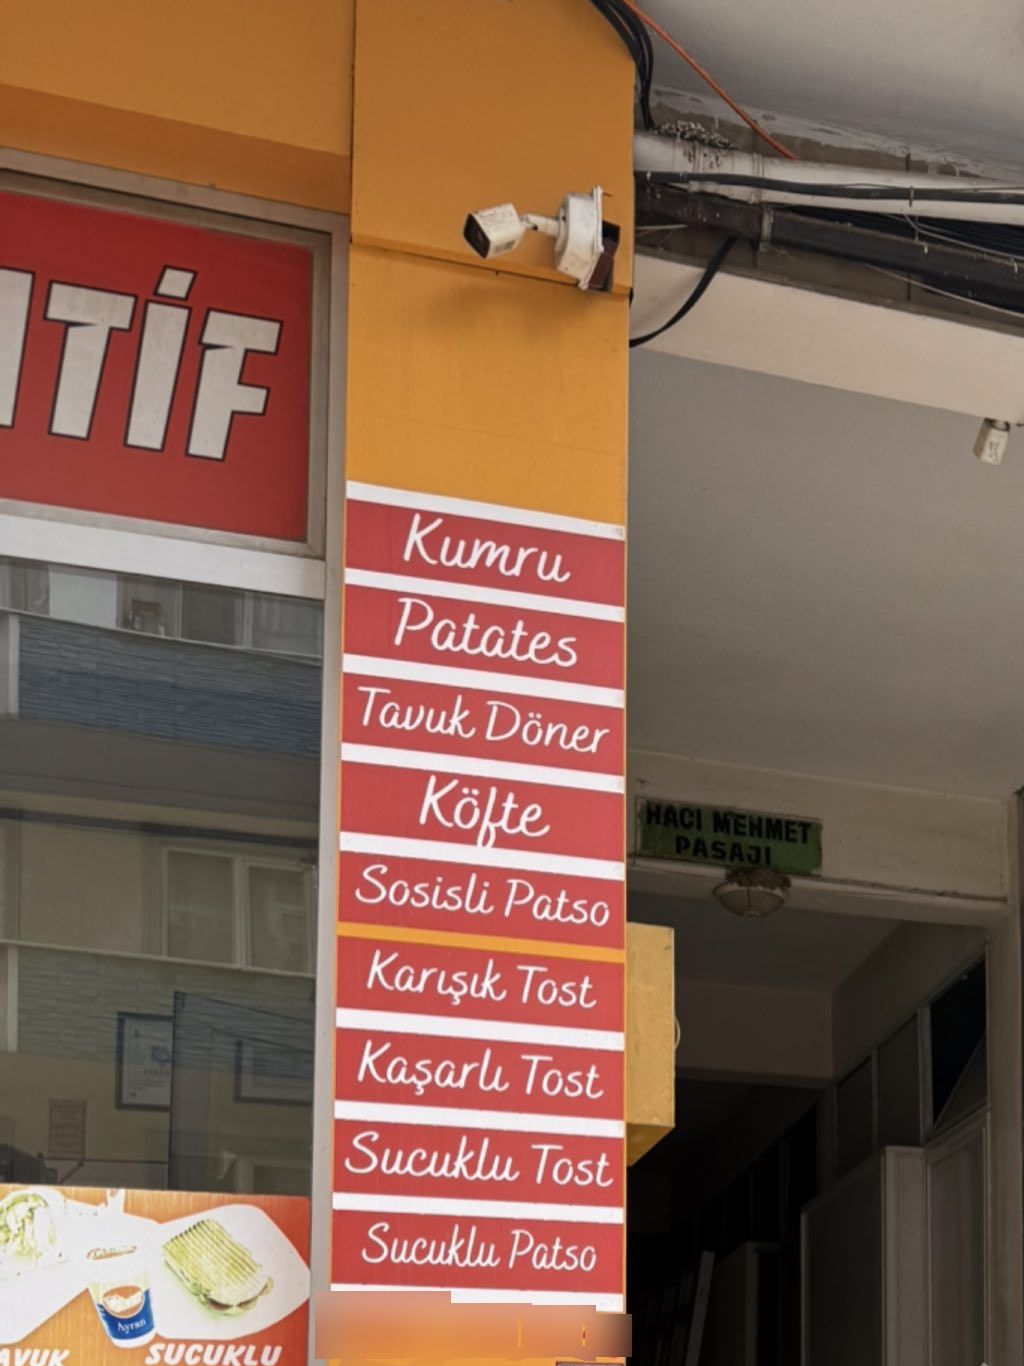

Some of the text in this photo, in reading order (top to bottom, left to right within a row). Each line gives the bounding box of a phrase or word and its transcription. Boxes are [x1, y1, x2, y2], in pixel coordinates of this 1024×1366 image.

[403, 512, 571, 583] Kumru
[394, 597, 578, 668] Patates
[357, 685, 611, 754] Tavuk Döner
[418, 774, 551, 849] Köfte
[646, 800, 813, 844] HACI MEHMET
[674, 835, 772, 865] PASAJI
[354, 864, 611, 928] Sosisli Patso
[366, 949, 598, 1009] Karışık Tost
[357, 1039, 605, 1100] Kaşarlı Tost
[344, 1130, 615, 1188] Sucuklu Tost
[361, 1222, 598, 1272] Sucuklu Patso
[117, 1318, 147, 1334] Ayran
